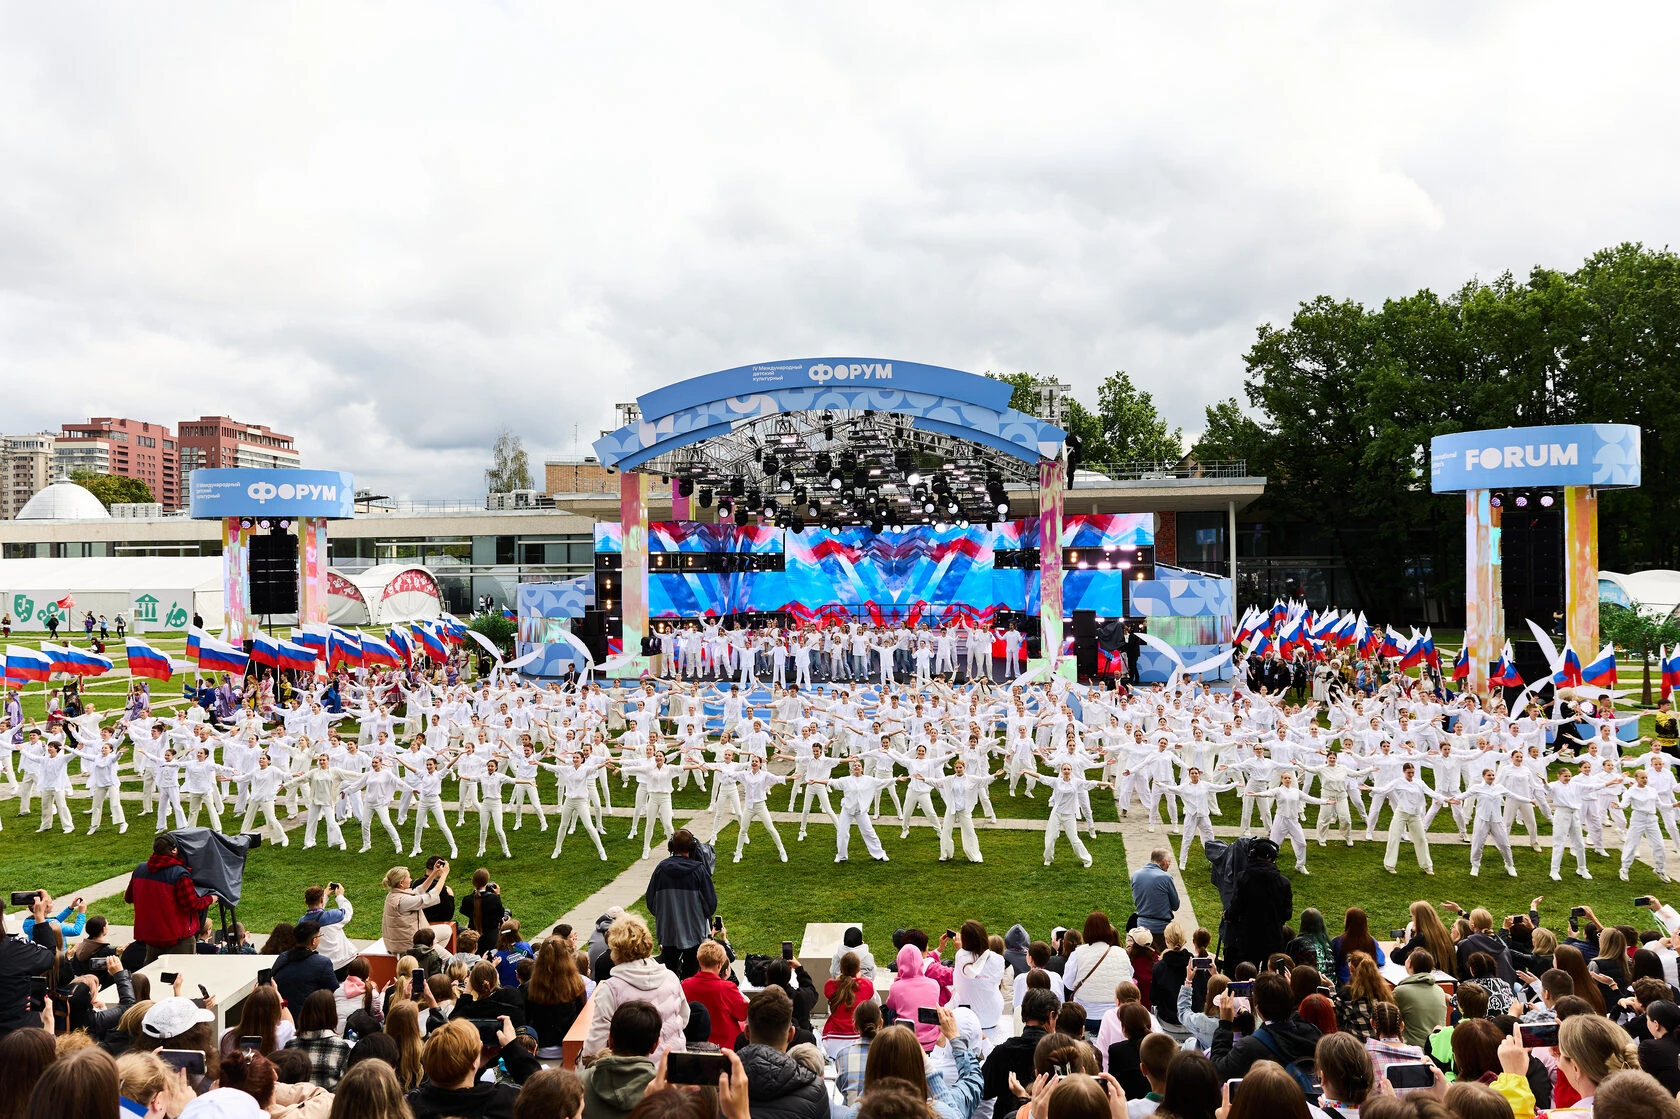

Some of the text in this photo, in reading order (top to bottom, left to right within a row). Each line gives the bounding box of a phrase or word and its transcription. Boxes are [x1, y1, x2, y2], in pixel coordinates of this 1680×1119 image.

[808, 363, 892, 385] ФОРУМ
[1466, 443, 1578, 471] FORUM
[247, 482, 336, 504] ФОРУМ
